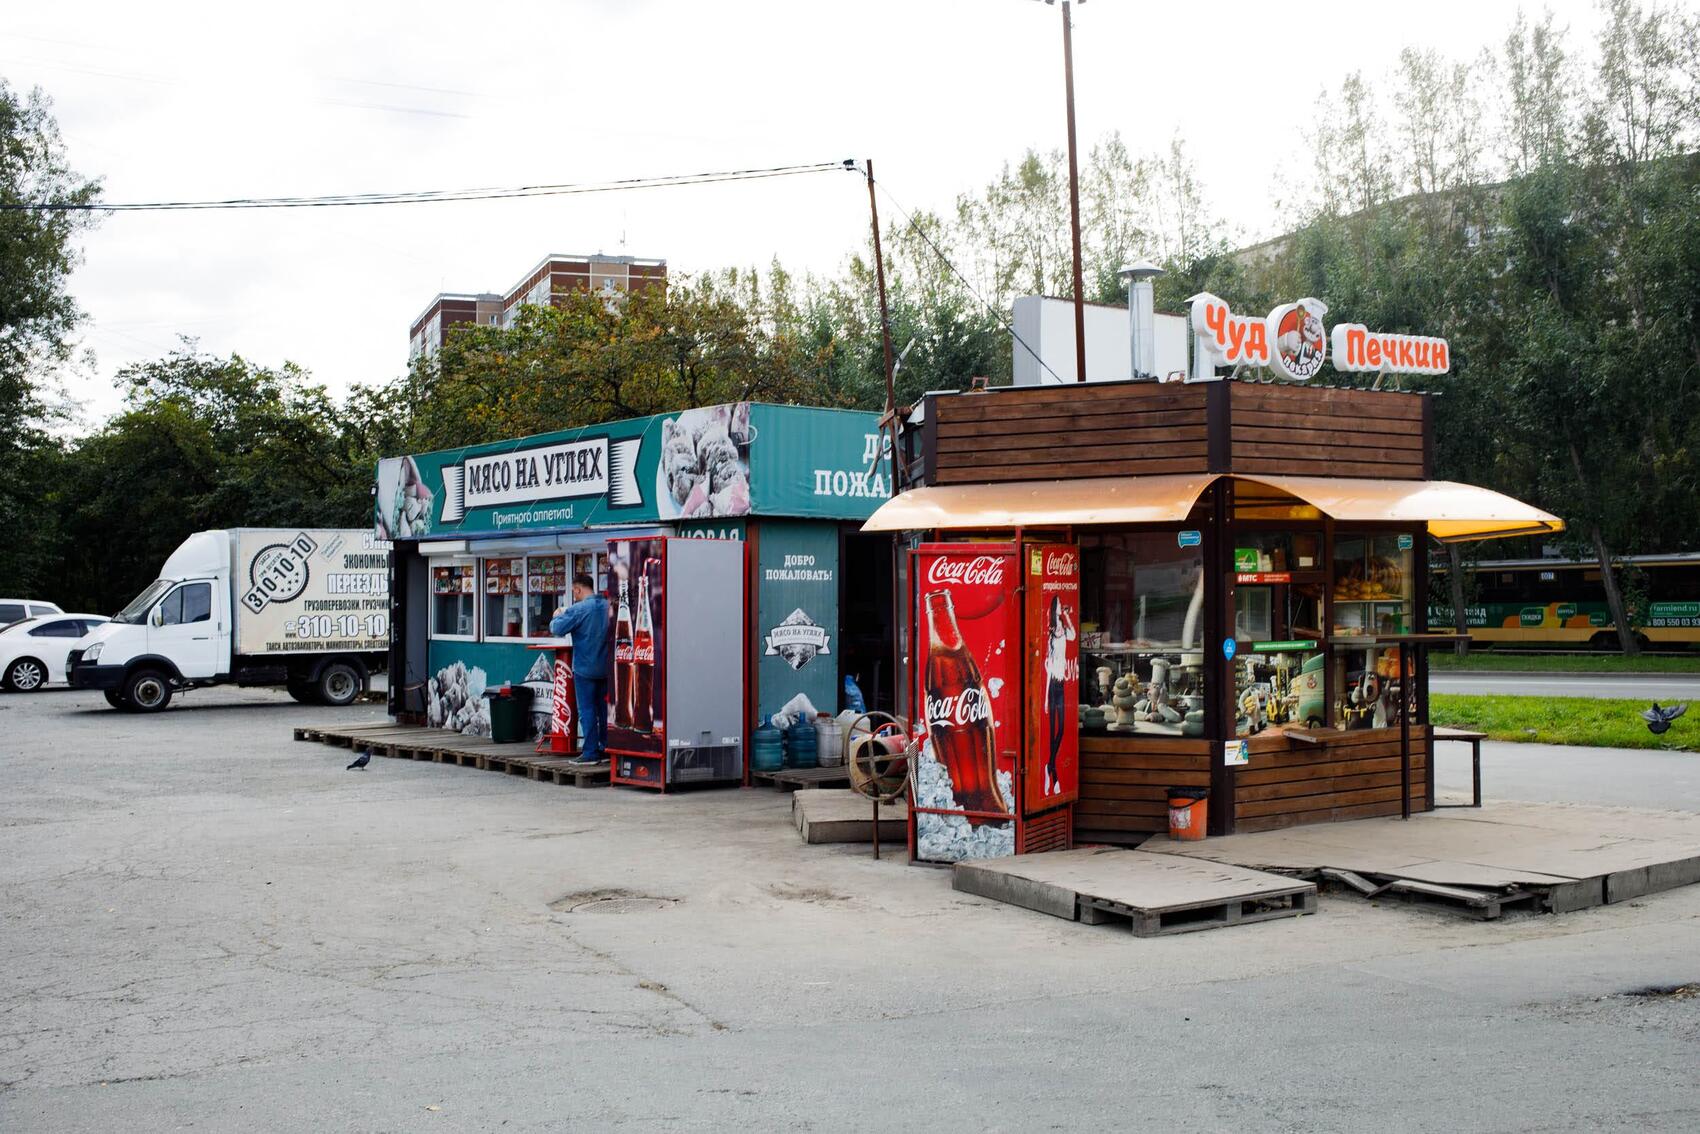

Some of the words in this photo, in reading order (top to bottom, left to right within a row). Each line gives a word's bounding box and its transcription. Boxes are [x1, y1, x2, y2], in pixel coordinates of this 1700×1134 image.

[1206, 304, 1267, 360] Чуд
[1347, 329, 1448, 369] Печкин
[1283, 351, 1323, 376] пекарня
[863, 434, 892, 464] ДО
[468, 460, 510, 494] МЯСО
[515, 455, 540, 488] НА
[543, 447, 603, 486] УГЛЯХ
[492, 511, 532, 530] Приятного
[248, 538, 312, 608] 310-10-10
[344, 554, 389, 569] ЭКОНОМНЫ
[784, 555, 815, 568] ДОБРО
[928, 555, 1005, 585] Coca-Cola
[1046, 552, 1075, 576] Coca-Cola
[765, 568, 833, 581] ПОЖАЛОВАТЬ!
[298, 614, 386, 638] 310-10-10
[1652, 617, 1666, 627] 800
[1667, 617, 1681, 627] 550
[1682, 617, 1691, 626] 03
[552, 658, 573, 737] Coca-Cola
